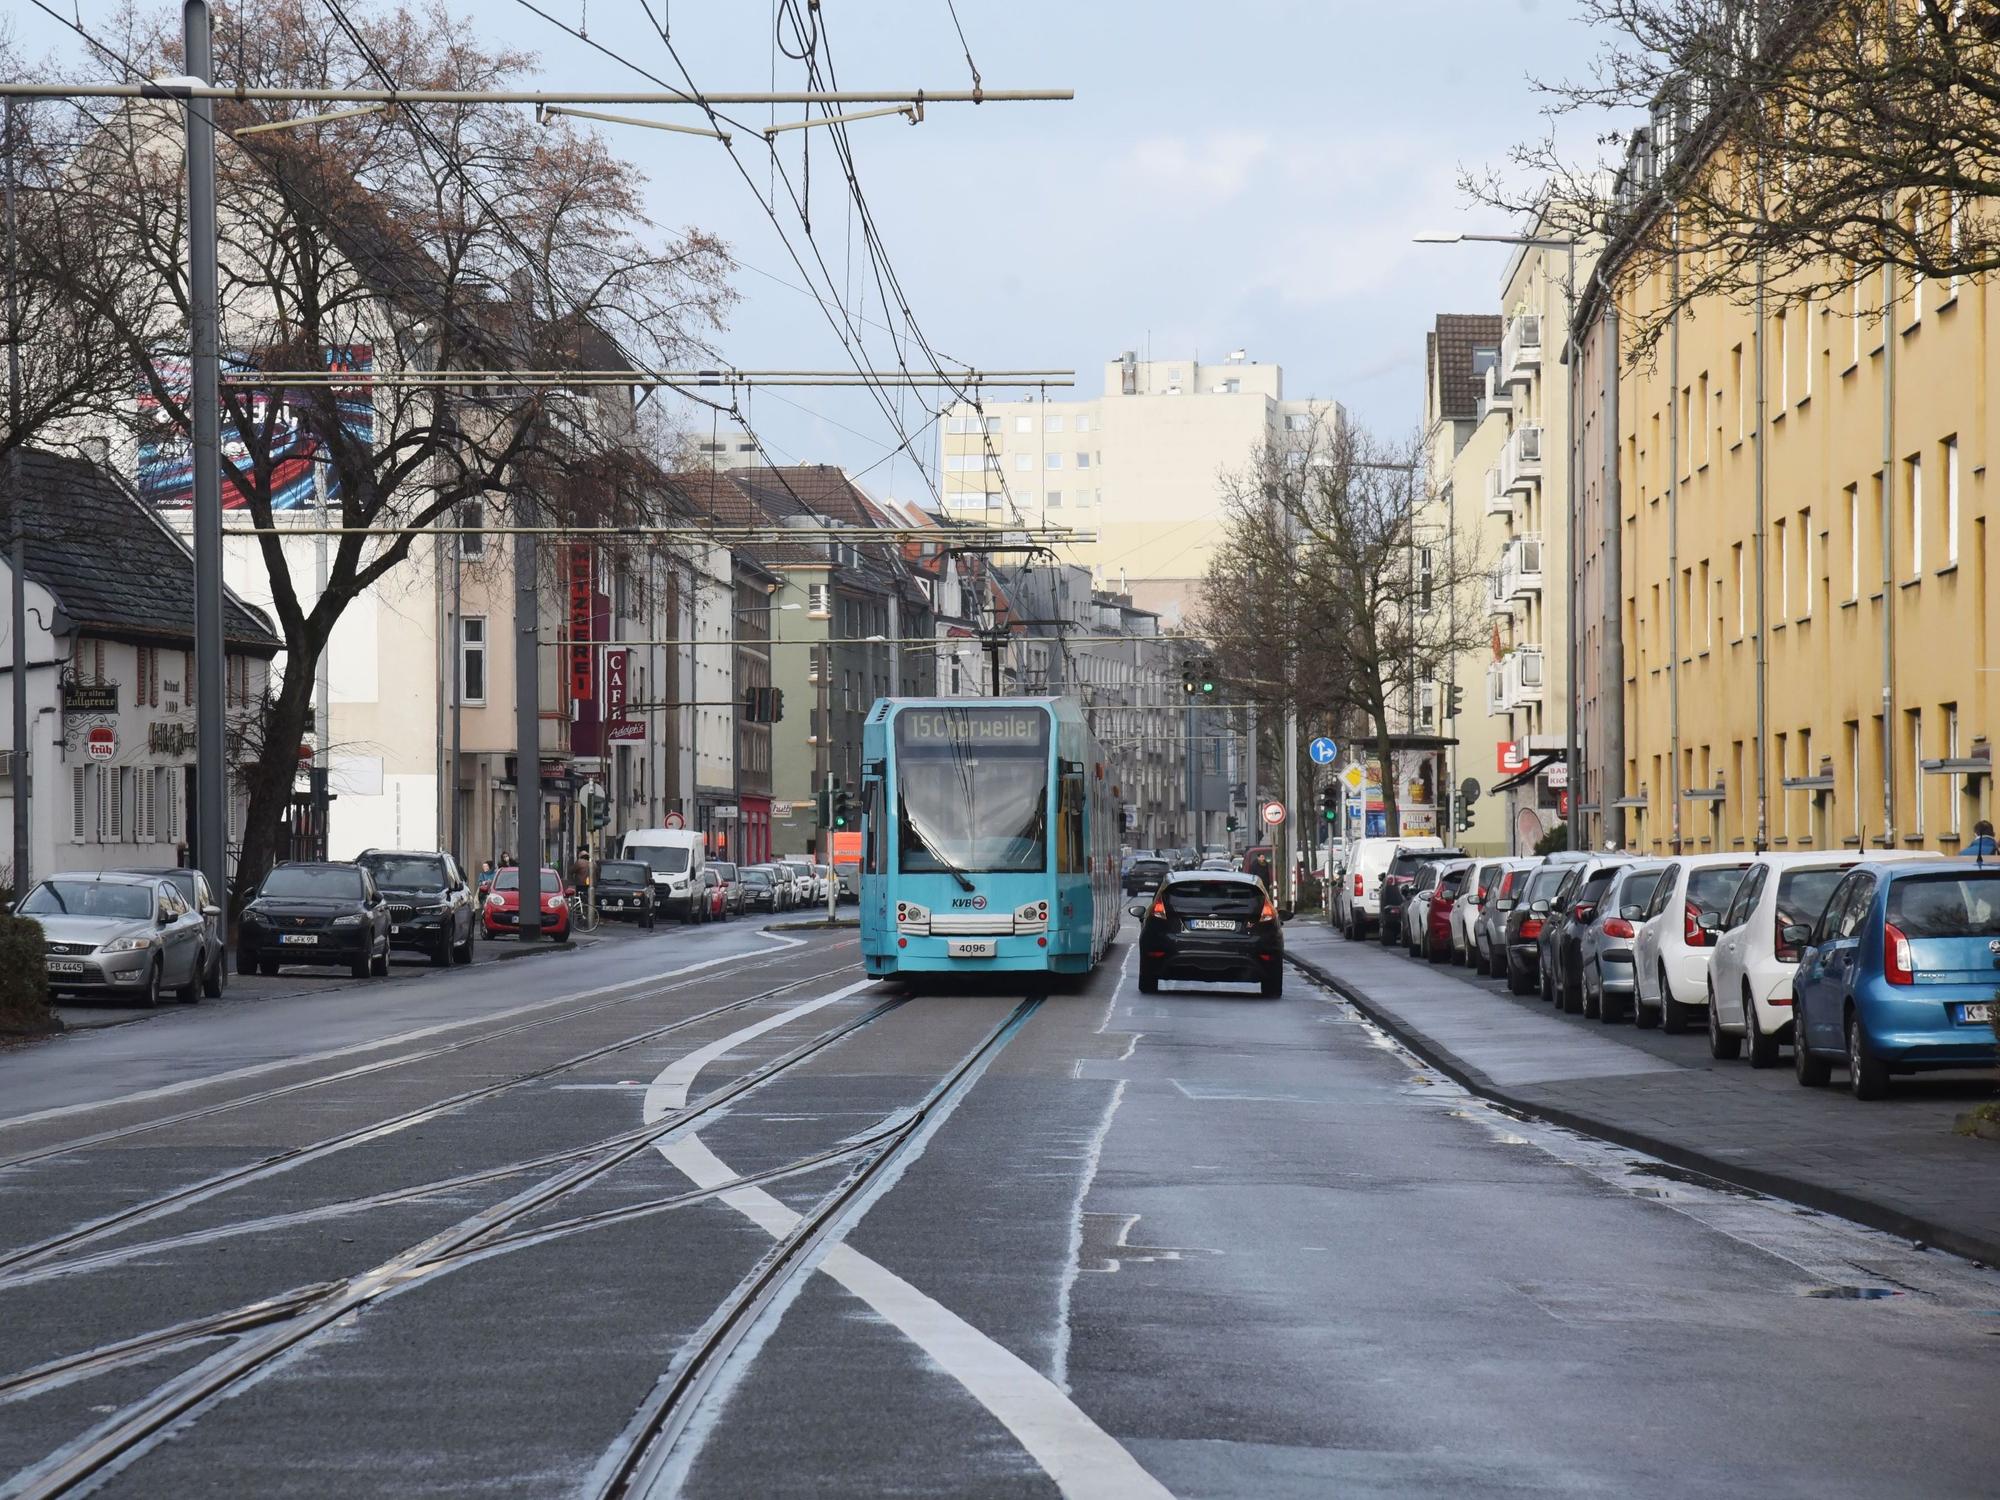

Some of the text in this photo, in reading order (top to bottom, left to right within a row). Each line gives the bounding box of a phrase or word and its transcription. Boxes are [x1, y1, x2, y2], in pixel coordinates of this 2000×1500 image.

[573, 549, 590, 690] METZGEREI
[65, 696, 115, 709] Zollgrenze
[912, 715, 1036, 738] 15 Chorweiler
[90, 744, 112, 755] früh
[952, 898, 972, 908] KVB
[959, 944, 986, 953] 4096
[62, 963, 82, 972] 4445
[1966, 1006, 1977, 1020] K
